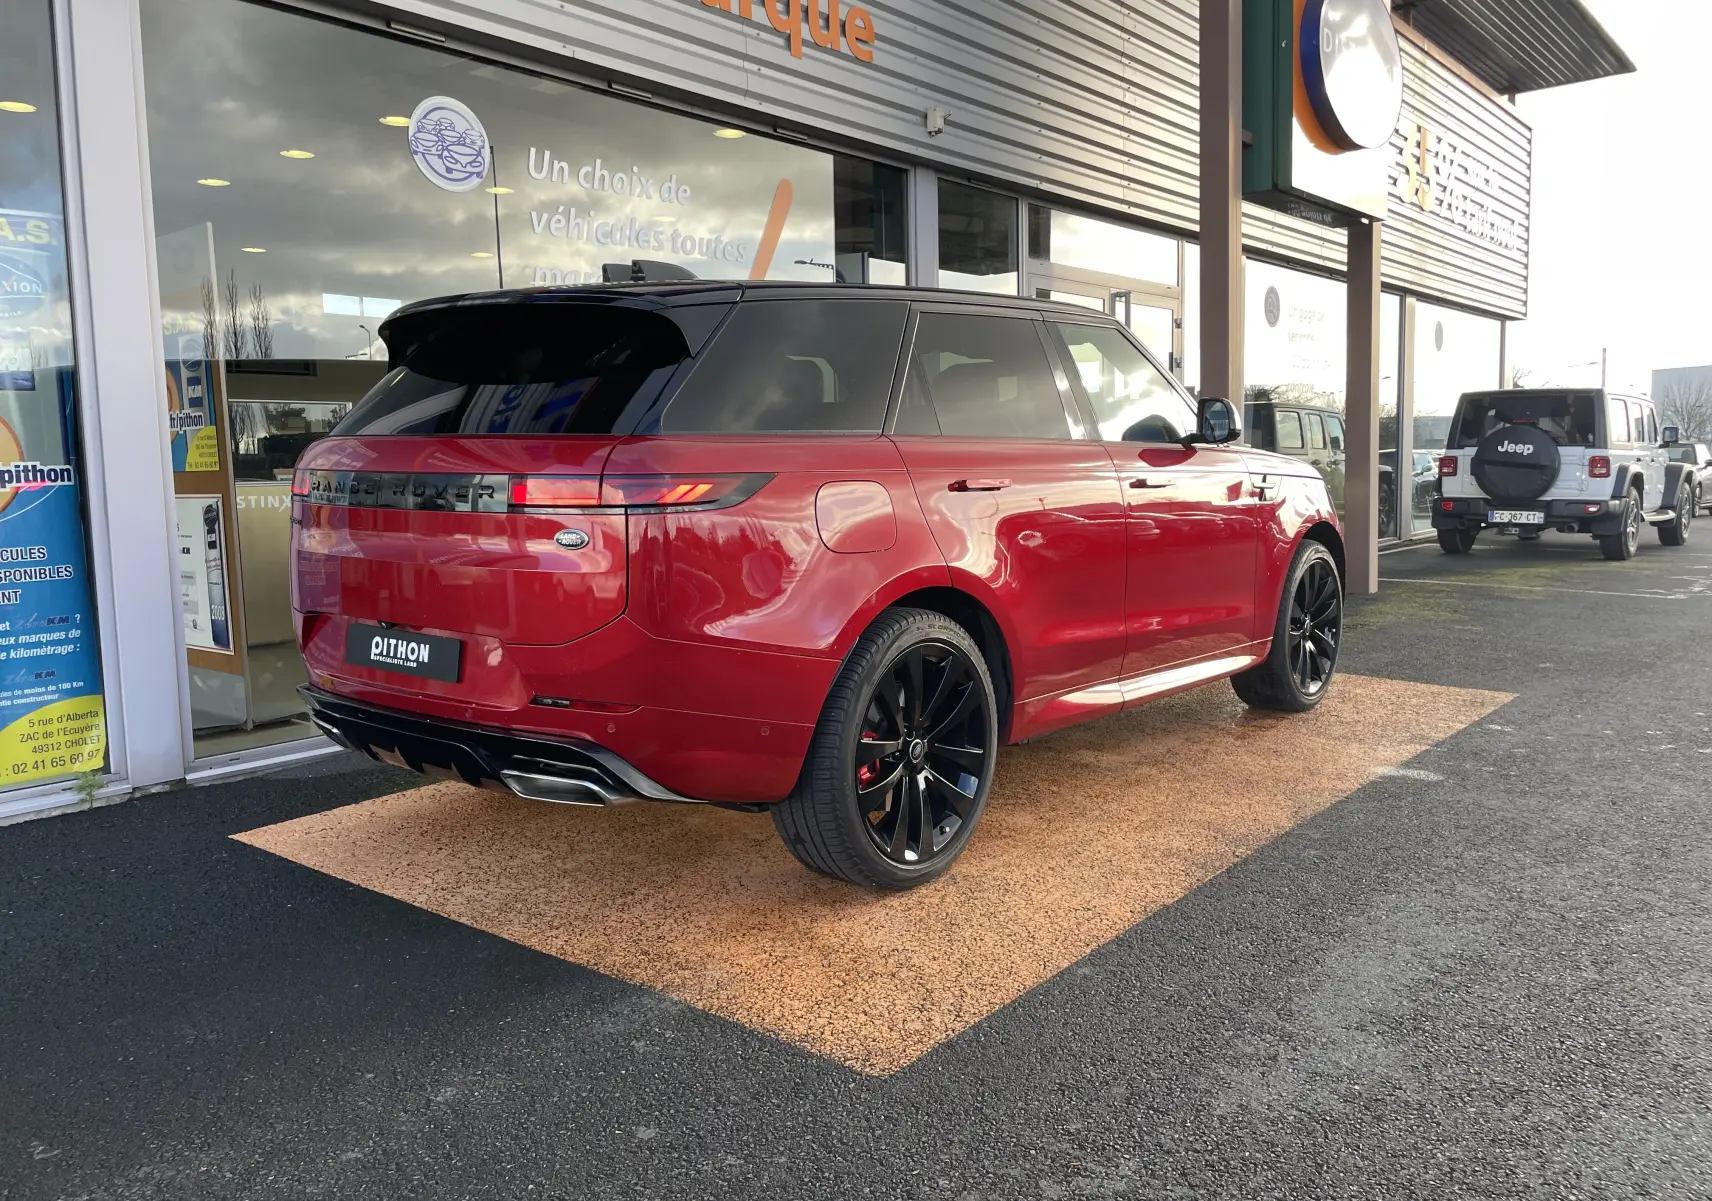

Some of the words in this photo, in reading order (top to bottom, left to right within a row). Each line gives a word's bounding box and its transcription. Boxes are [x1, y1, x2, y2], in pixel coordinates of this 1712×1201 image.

[528, 147, 569, 185] Un
[578, 158, 654, 200] choix
[660, 174, 691, 206] de
[530, 205, 665, 252] véhicules
[671, 228, 748, 263] toutes
[1498, 441, 1534, 455] Jeep
[0, 465, 72, 488] pithon
[311, 476, 377, 495] RANGE
[393, 480, 495, 499] ROVER
[0, 621, 11, 631] et
[19, 629, 65, 643] marques
[69, 628, 81, 638] de
[371, 636, 430, 663] PITHON
[24, 686, 46, 694] moins
[28, 719, 35, 728] 5
[38, 717, 54, 726] rue
[57, 709, 99, 724] d'Alberta
[20, 731, 39, 743] ZAC
[42, 730, 54, 739] de
[31, 741, 62, 754] 49312
[64, 734, 101, 749] CHOLET
[12, 762, 28, 775] 02
[32, 759, 46, 771] 41
[51, 756, 66, 768] 65
[69, 752, 84, 764] 60
[87, 748, 100, 760] 97
